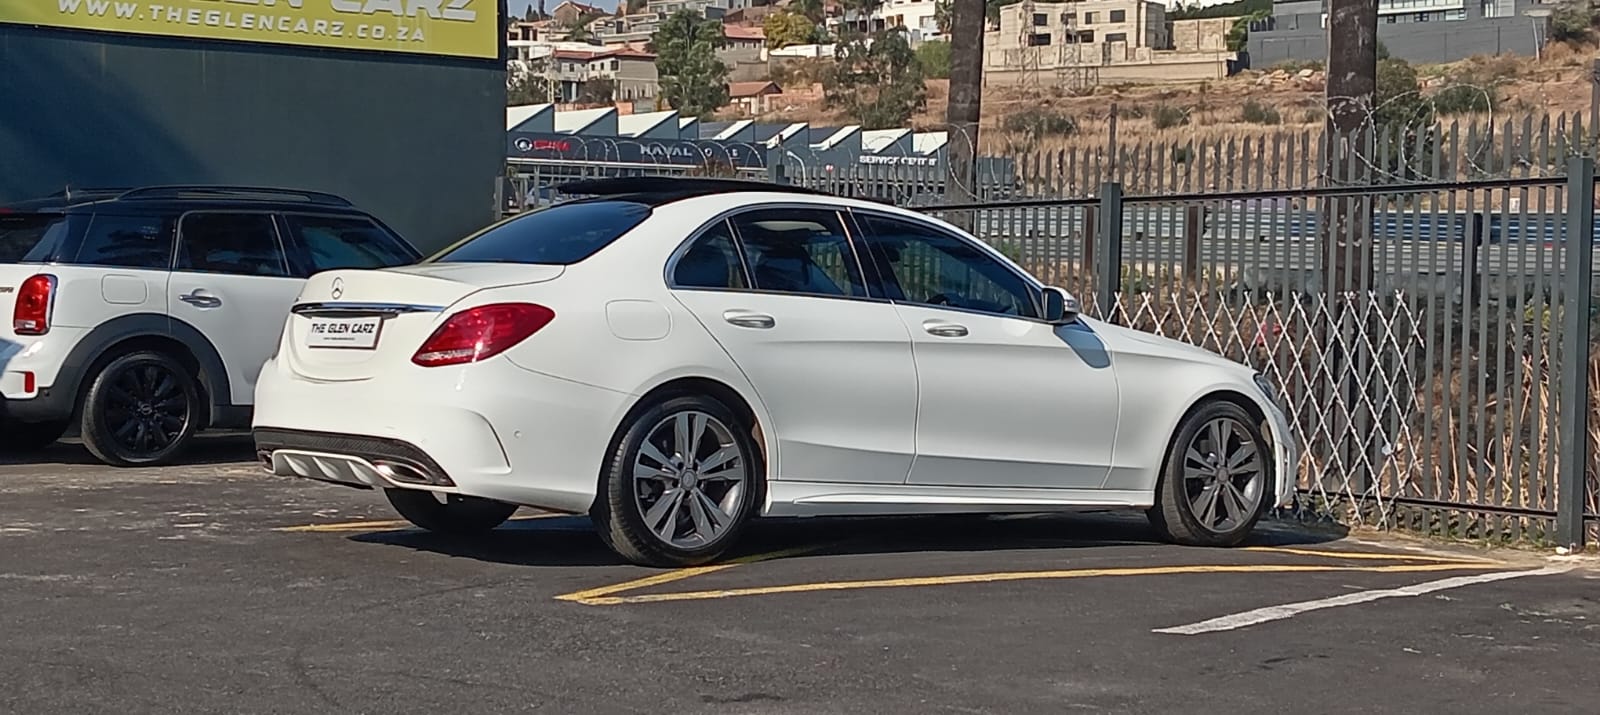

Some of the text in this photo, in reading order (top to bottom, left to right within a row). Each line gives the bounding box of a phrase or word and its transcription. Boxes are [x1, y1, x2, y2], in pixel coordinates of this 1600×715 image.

[57, 0, 425, 42] WWW.THEGLENCARZ.CO.ZA
[311, 323, 375, 333] THE GLEN CARZ
